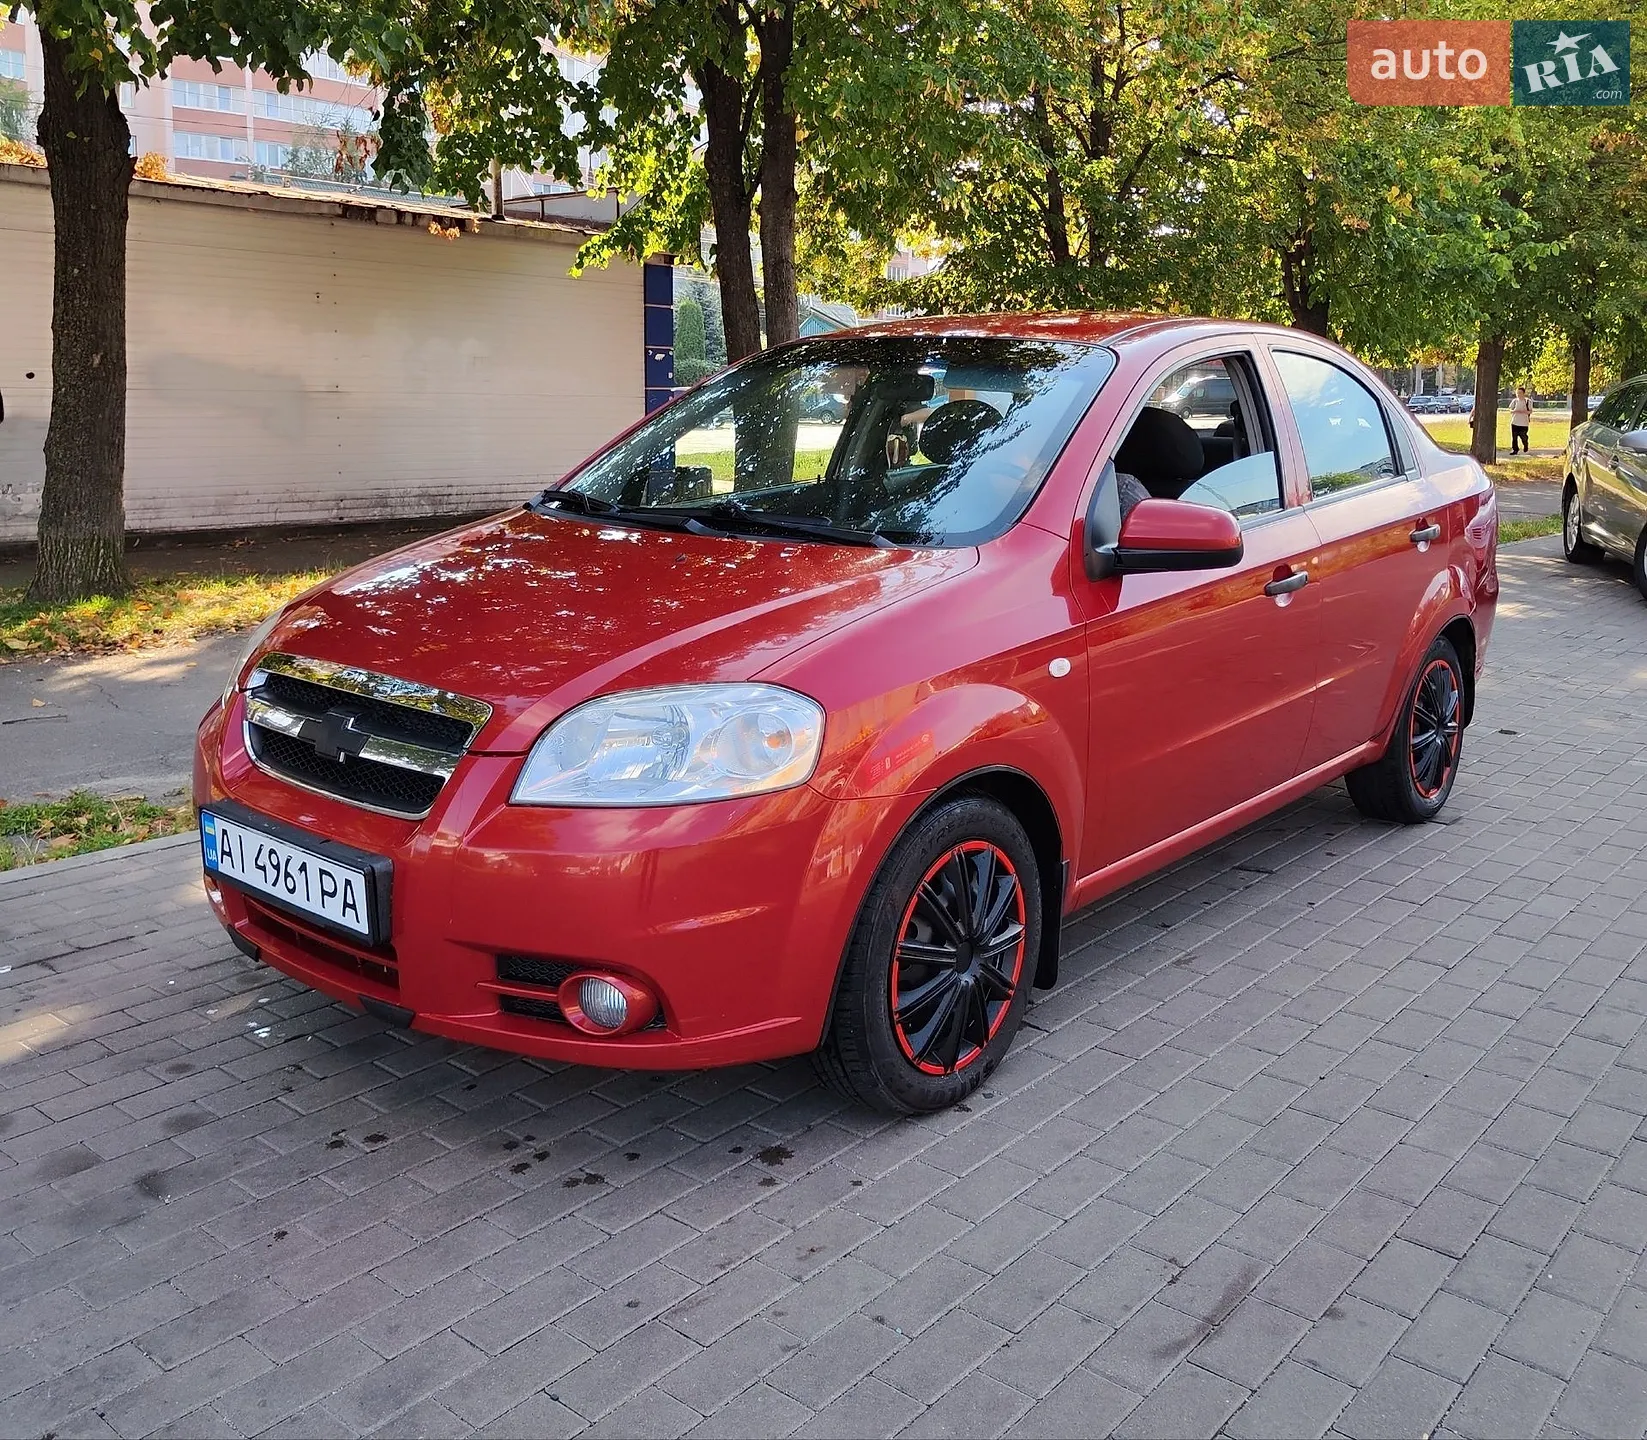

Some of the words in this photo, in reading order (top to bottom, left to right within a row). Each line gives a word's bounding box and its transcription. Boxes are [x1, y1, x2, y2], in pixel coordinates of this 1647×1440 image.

[206, 848, 217, 861] UA
[220, 828, 245, 874] AI
[254, 843, 310, 902] 4961
[318, 867, 360, 924] PA
